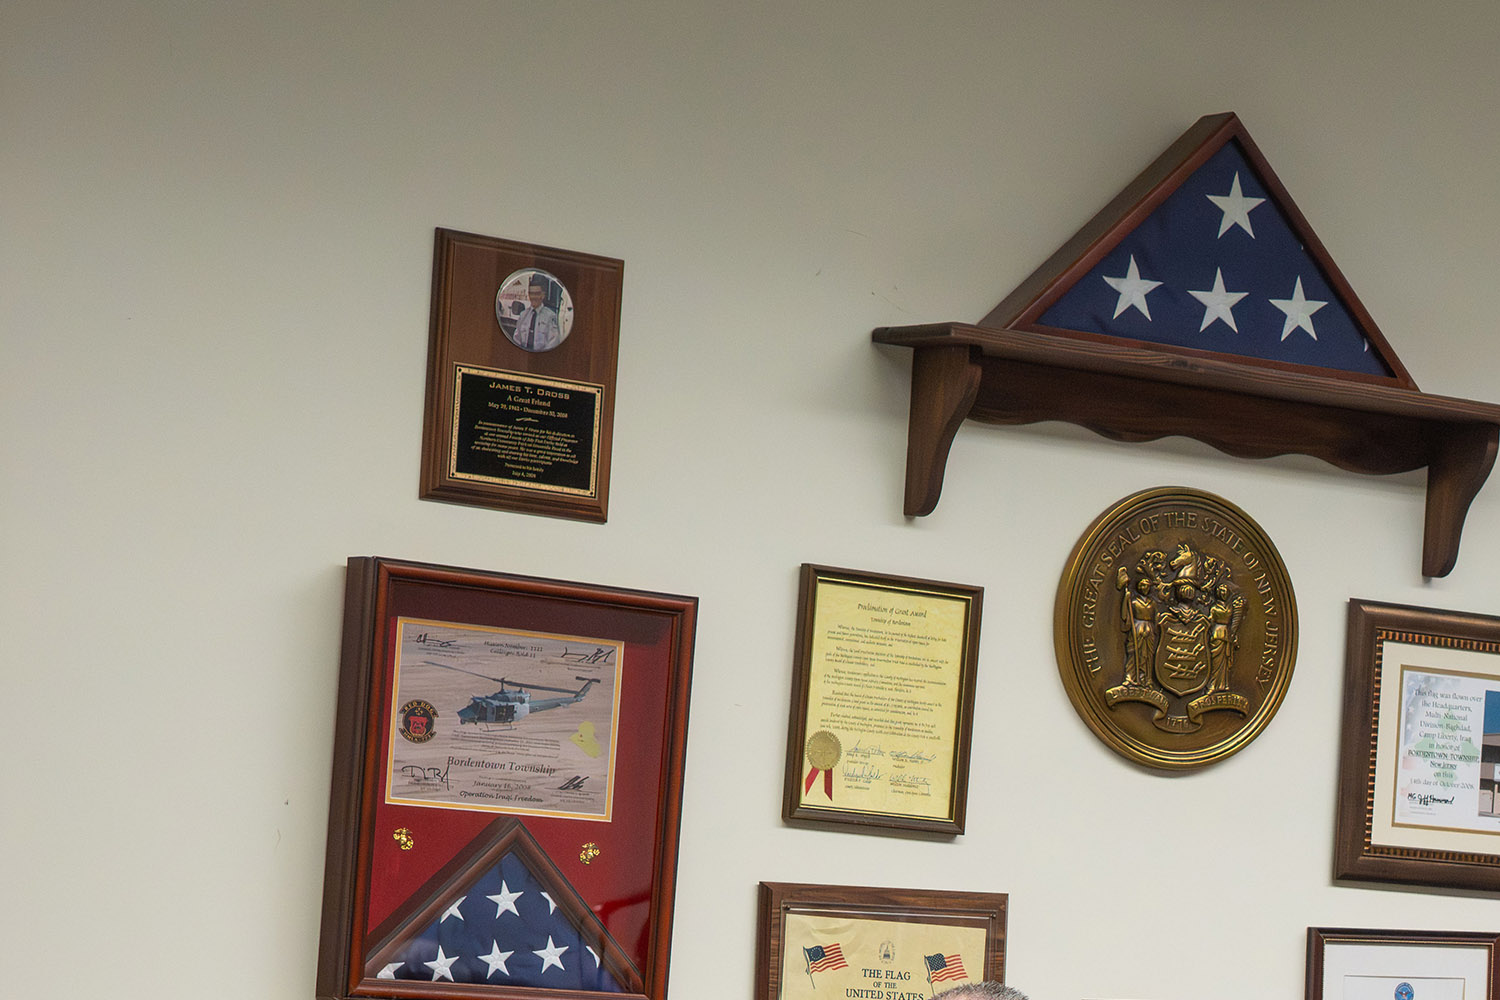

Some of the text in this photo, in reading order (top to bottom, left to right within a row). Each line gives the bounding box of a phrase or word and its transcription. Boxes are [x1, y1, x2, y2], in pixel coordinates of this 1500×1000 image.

[490, 382, 521, 393] JAMES
[524, 386, 533, 394] T.
[1082, 512, 1280, 690] THE GREAT SEAL OF THE STATE OF NEW JERSEY
[1452, 693, 1469, 701] flown
[447, 756, 556, 776] Bordentown Township
[473, 780, 501, 791] January
[460, 790, 494, 801] Operation
[514, 794, 544, 804] Freedom
[862, 968, 911, 981] THE FLAG
[846, 988, 884, 1000] UNITED
